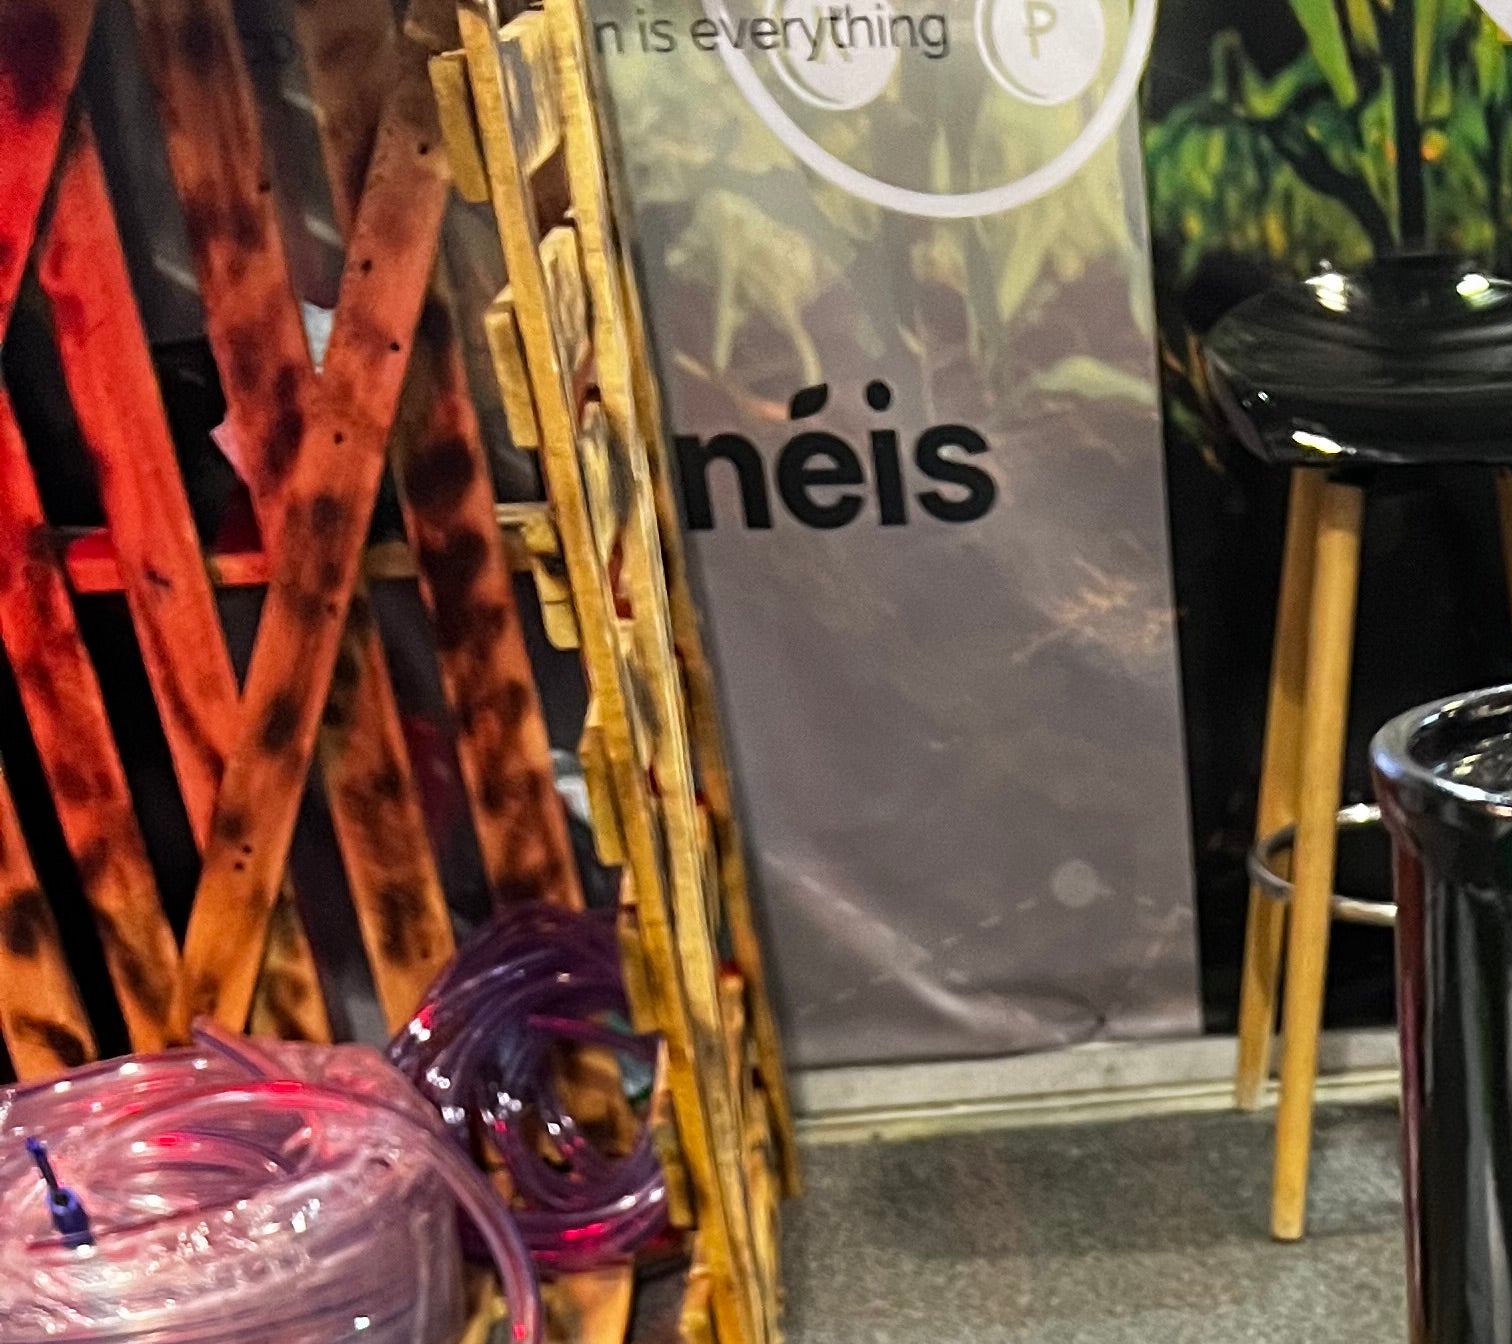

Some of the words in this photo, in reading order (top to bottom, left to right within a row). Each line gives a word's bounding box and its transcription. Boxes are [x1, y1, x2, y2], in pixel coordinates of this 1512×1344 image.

[640, 9, 677, 53] is
[690, 4, 949, 62] everything
[673, 378, 997, 530] néis
